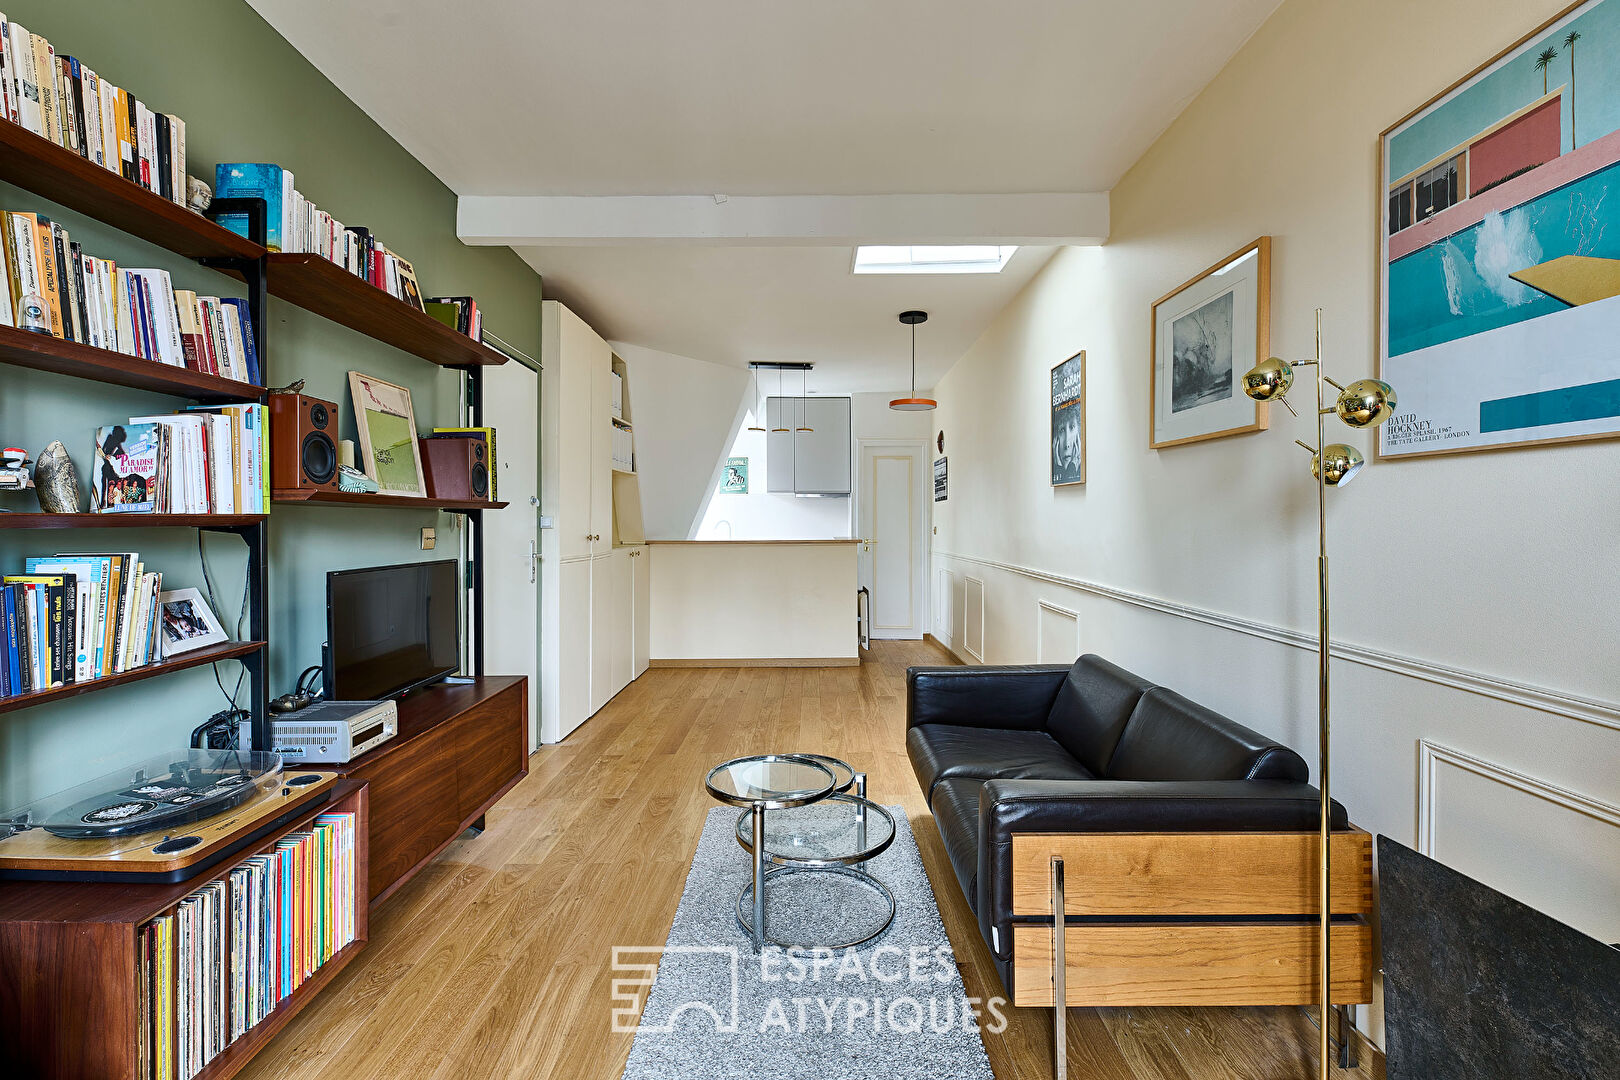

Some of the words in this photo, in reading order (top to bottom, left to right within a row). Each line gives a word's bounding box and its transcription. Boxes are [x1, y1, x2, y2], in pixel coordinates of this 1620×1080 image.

[44, 256, 55, 292] APOCALYPSE
[1064, 371, 1081, 389] SARAH
[1053, 384, 1081, 406] BERNHARDT
[1388, 414, 1416, 426] DAVID
[1388, 420, 1432, 434] HOCKNEY
[1392, 432, 1412, 440] BIGGER
[1438, 426, 1452, 434] 1967
[1444, 430, 1470, 439] LONDON
[98, 614, 104, 622] LA
